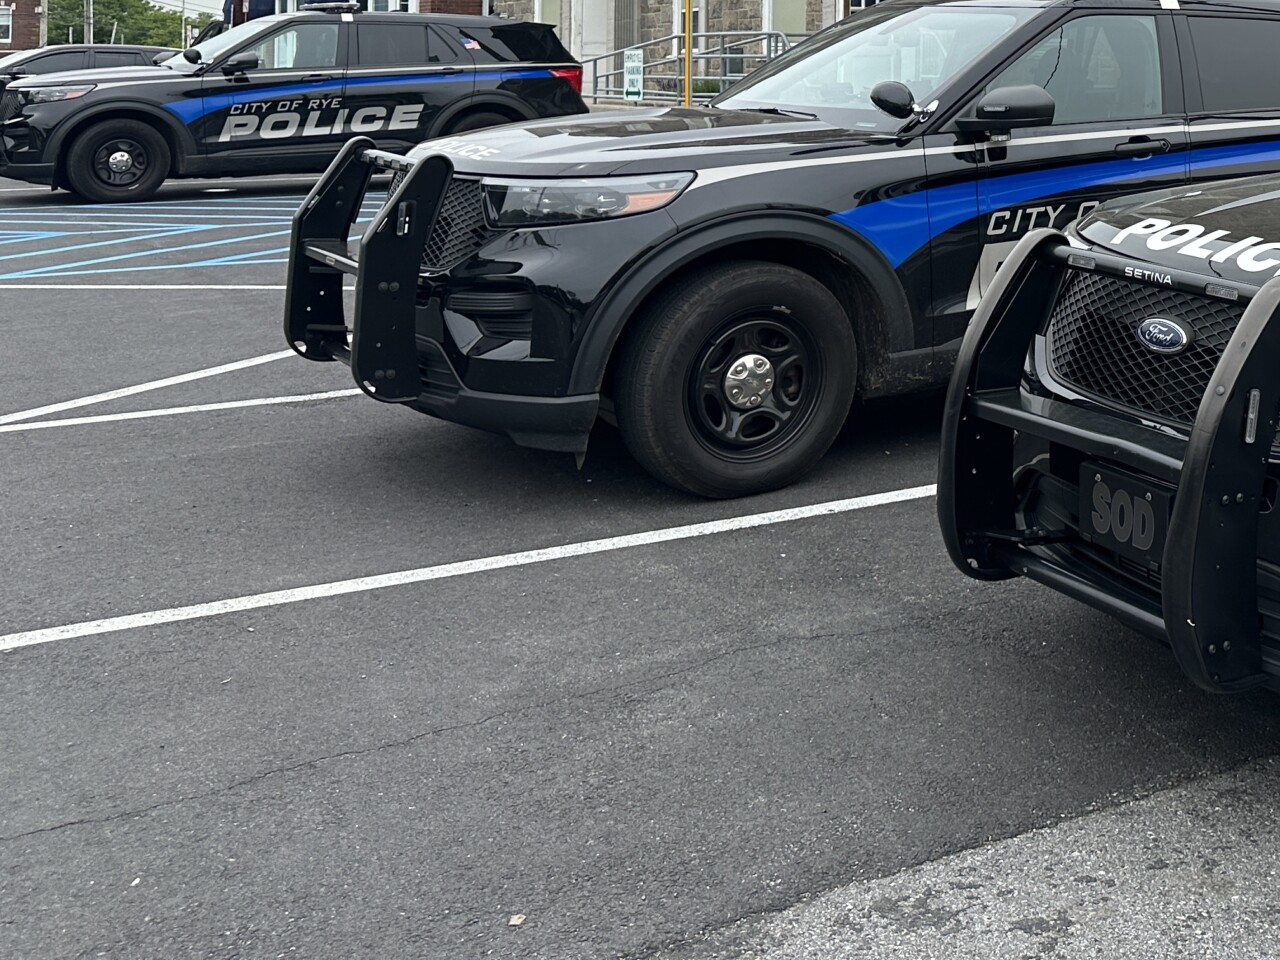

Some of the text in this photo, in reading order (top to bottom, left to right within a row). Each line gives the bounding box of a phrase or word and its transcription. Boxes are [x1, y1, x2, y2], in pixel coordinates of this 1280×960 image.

[230, 98, 342, 114] CITY OF RYE
[218, 104, 424, 142] POLICE
[986, 204, 1066, 235] CITY
[1124, 266, 1172, 285] SETINA
[1146, 324, 1174, 342] Ford
[1091, 482, 1154, 550] SOD
